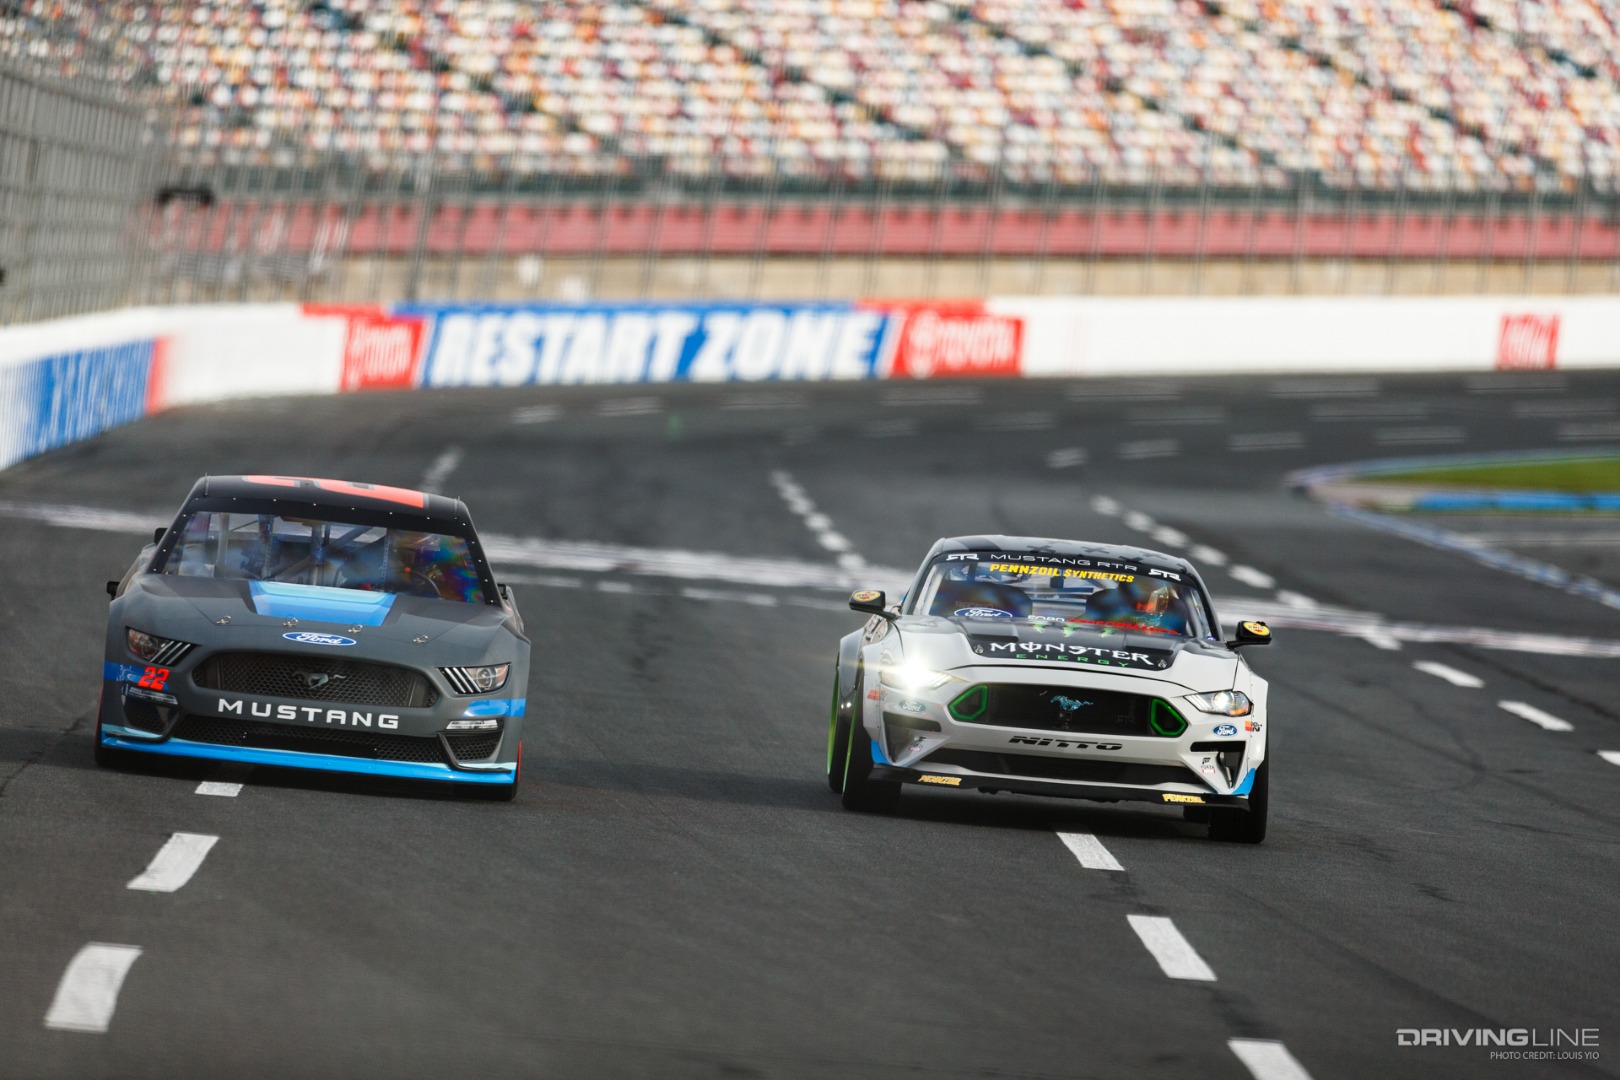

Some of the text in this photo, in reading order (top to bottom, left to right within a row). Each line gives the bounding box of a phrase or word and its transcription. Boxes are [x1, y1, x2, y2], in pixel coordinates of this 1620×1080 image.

[429, 312, 701, 387] RESTART
[688, 310, 884, 382] ZONE
[989, 563, 1135, 583] PENNZOIL SYNTHETICS
[991, 553, 1138, 572] MUSTANG RTR
[990, 641, 1154, 666] MONSTER
[1016, 653, 1129, 667] ENERGY
[137, 665, 170, 691] 22
[217, 698, 399, 730] MUSTANG
[1216, 724, 1235, 736] Ford
